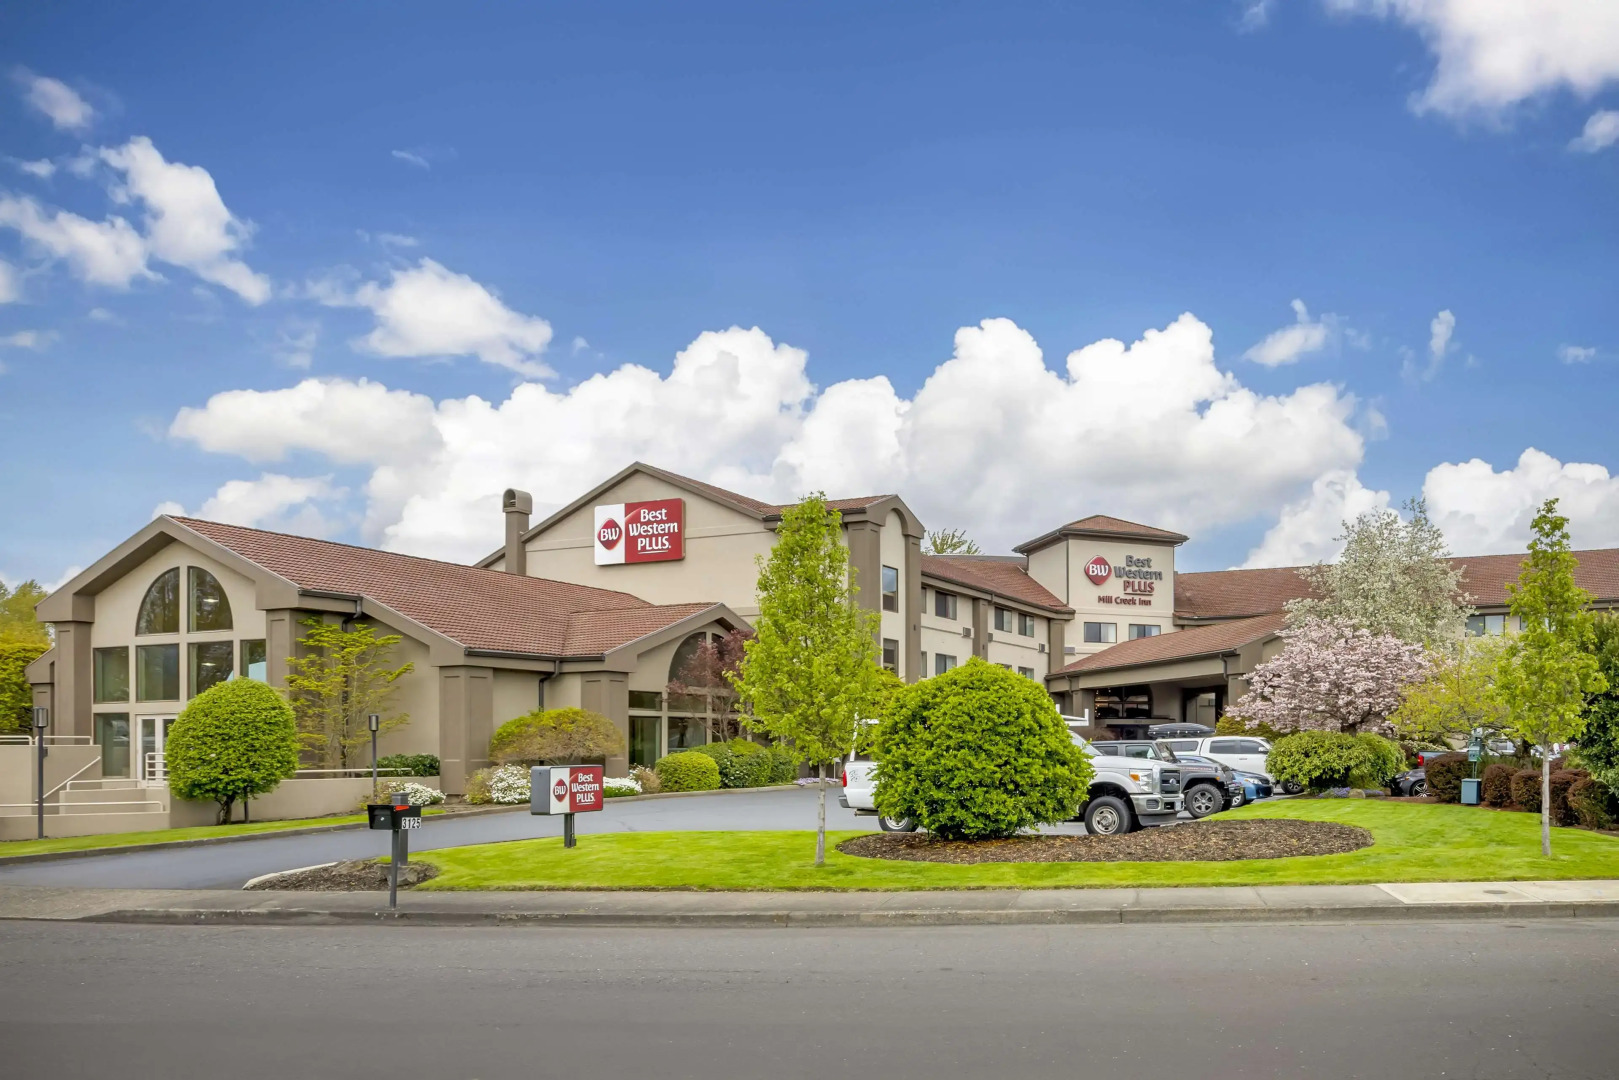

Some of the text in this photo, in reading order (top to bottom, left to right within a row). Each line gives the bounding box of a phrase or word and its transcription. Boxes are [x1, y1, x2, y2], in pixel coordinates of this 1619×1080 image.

[640, 508, 667, 522] Best
[600, 527, 620, 541] BW
[628, 522, 678, 537] Western
[1125, 554, 1152, 568] Best
[1089, 564, 1109, 576] BW
[1113, 565, 1163, 581] Western
[1123, 580, 1155, 593] PLUS
[1097, 595, 1152, 606] Mill Creek Inn
[578, 773, 594, 783] Best
[554, 786, 566, 796] BW
[571, 783, 600, 793] Western
[402, 817, 420, 828] 3125
